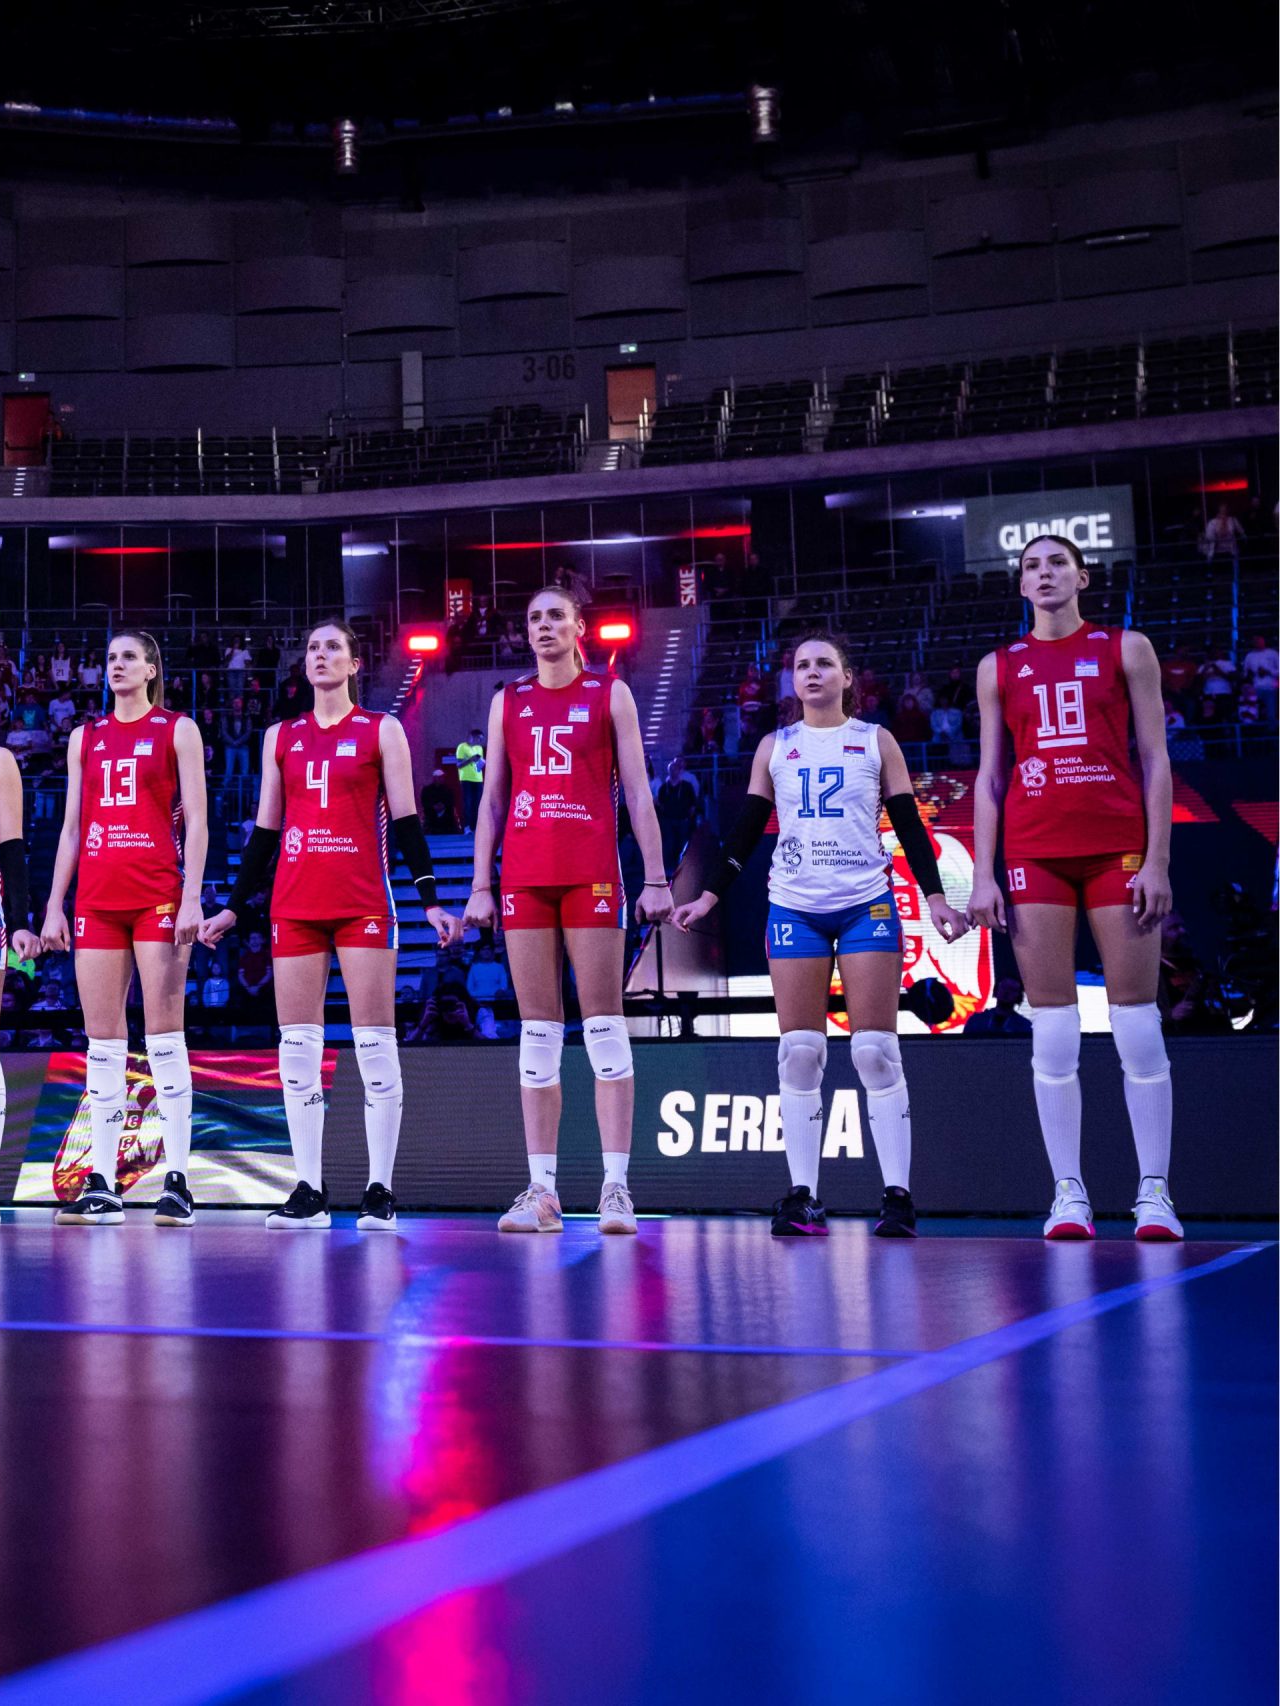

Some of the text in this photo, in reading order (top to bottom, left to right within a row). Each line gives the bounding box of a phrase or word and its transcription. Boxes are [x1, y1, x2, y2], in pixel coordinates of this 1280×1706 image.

[522, 354, 576, 383] 3-06
[1033, 680, 1086, 738] 18
[529, 725, 574, 776] 15
[1054, 757, 1083, 765] БАНКА
[1054, 764, 1109, 774] ПОШТАНСКА
[99, 758, 137, 807] 13
[1055, 774, 1116, 784] ШТЕДИОНИЦА
[306, 760, 329, 808] 4
[797, 766, 844, 818] 12
[541, 793, 564, 801] БАНКА
[540, 802, 586, 811] ПОШТАНСКА
[540, 811, 592, 820] ШТЕДИОНИЦА
[107, 832, 150, 840] ПОШТАНСКА
[307, 836, 352, 844] ПОШТАНСКА
[107, 840, 155, 848] ШТЕДИОНИЦА
[811, 840, 838, 848] БАНКА
[307, 845, 359, 853] ШТЕДИОНИЦА
[812, 849, 862, 857] ПОШТАНСКА
[812, 858, 869, 867] ШТЕДИОНИЦА
[1007, 867, 1027, 892] 18
[502, 893, 515, 916] 15
[773, 923, 794, 946] 12
[526, 1029, 547, 1038] MIKASA
[589, 1026, 610, 1034] MIKASA
[657, 1089, 864, 1159] SERBA
